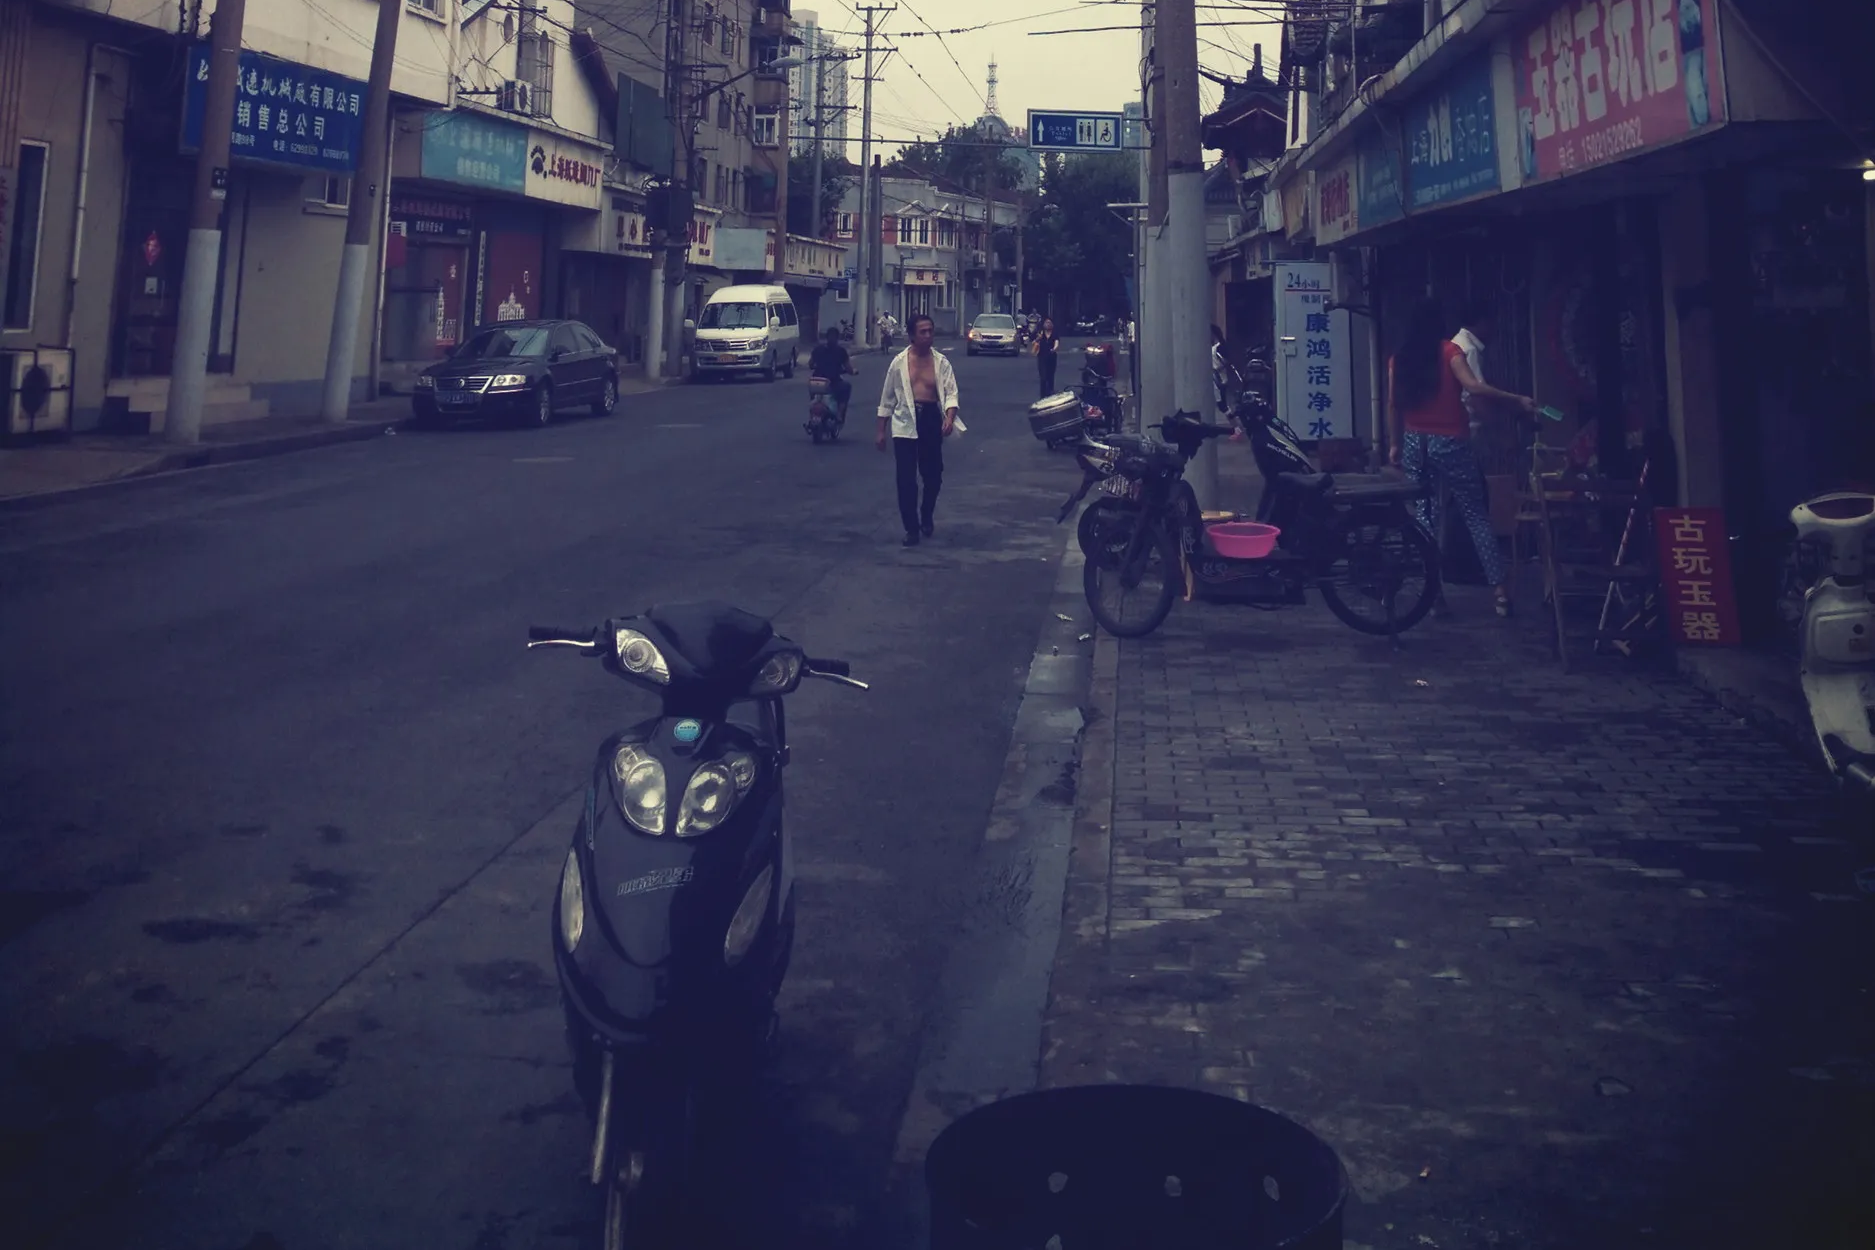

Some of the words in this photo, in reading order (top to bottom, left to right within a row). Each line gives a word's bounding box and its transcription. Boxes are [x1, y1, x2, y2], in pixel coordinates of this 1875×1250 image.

[236, 100, 325, 141] 销售总公司
[1305, 311, 1334, 440] 康鸿活净水
[1668, 514, 1722, 641] 古玩玉器
